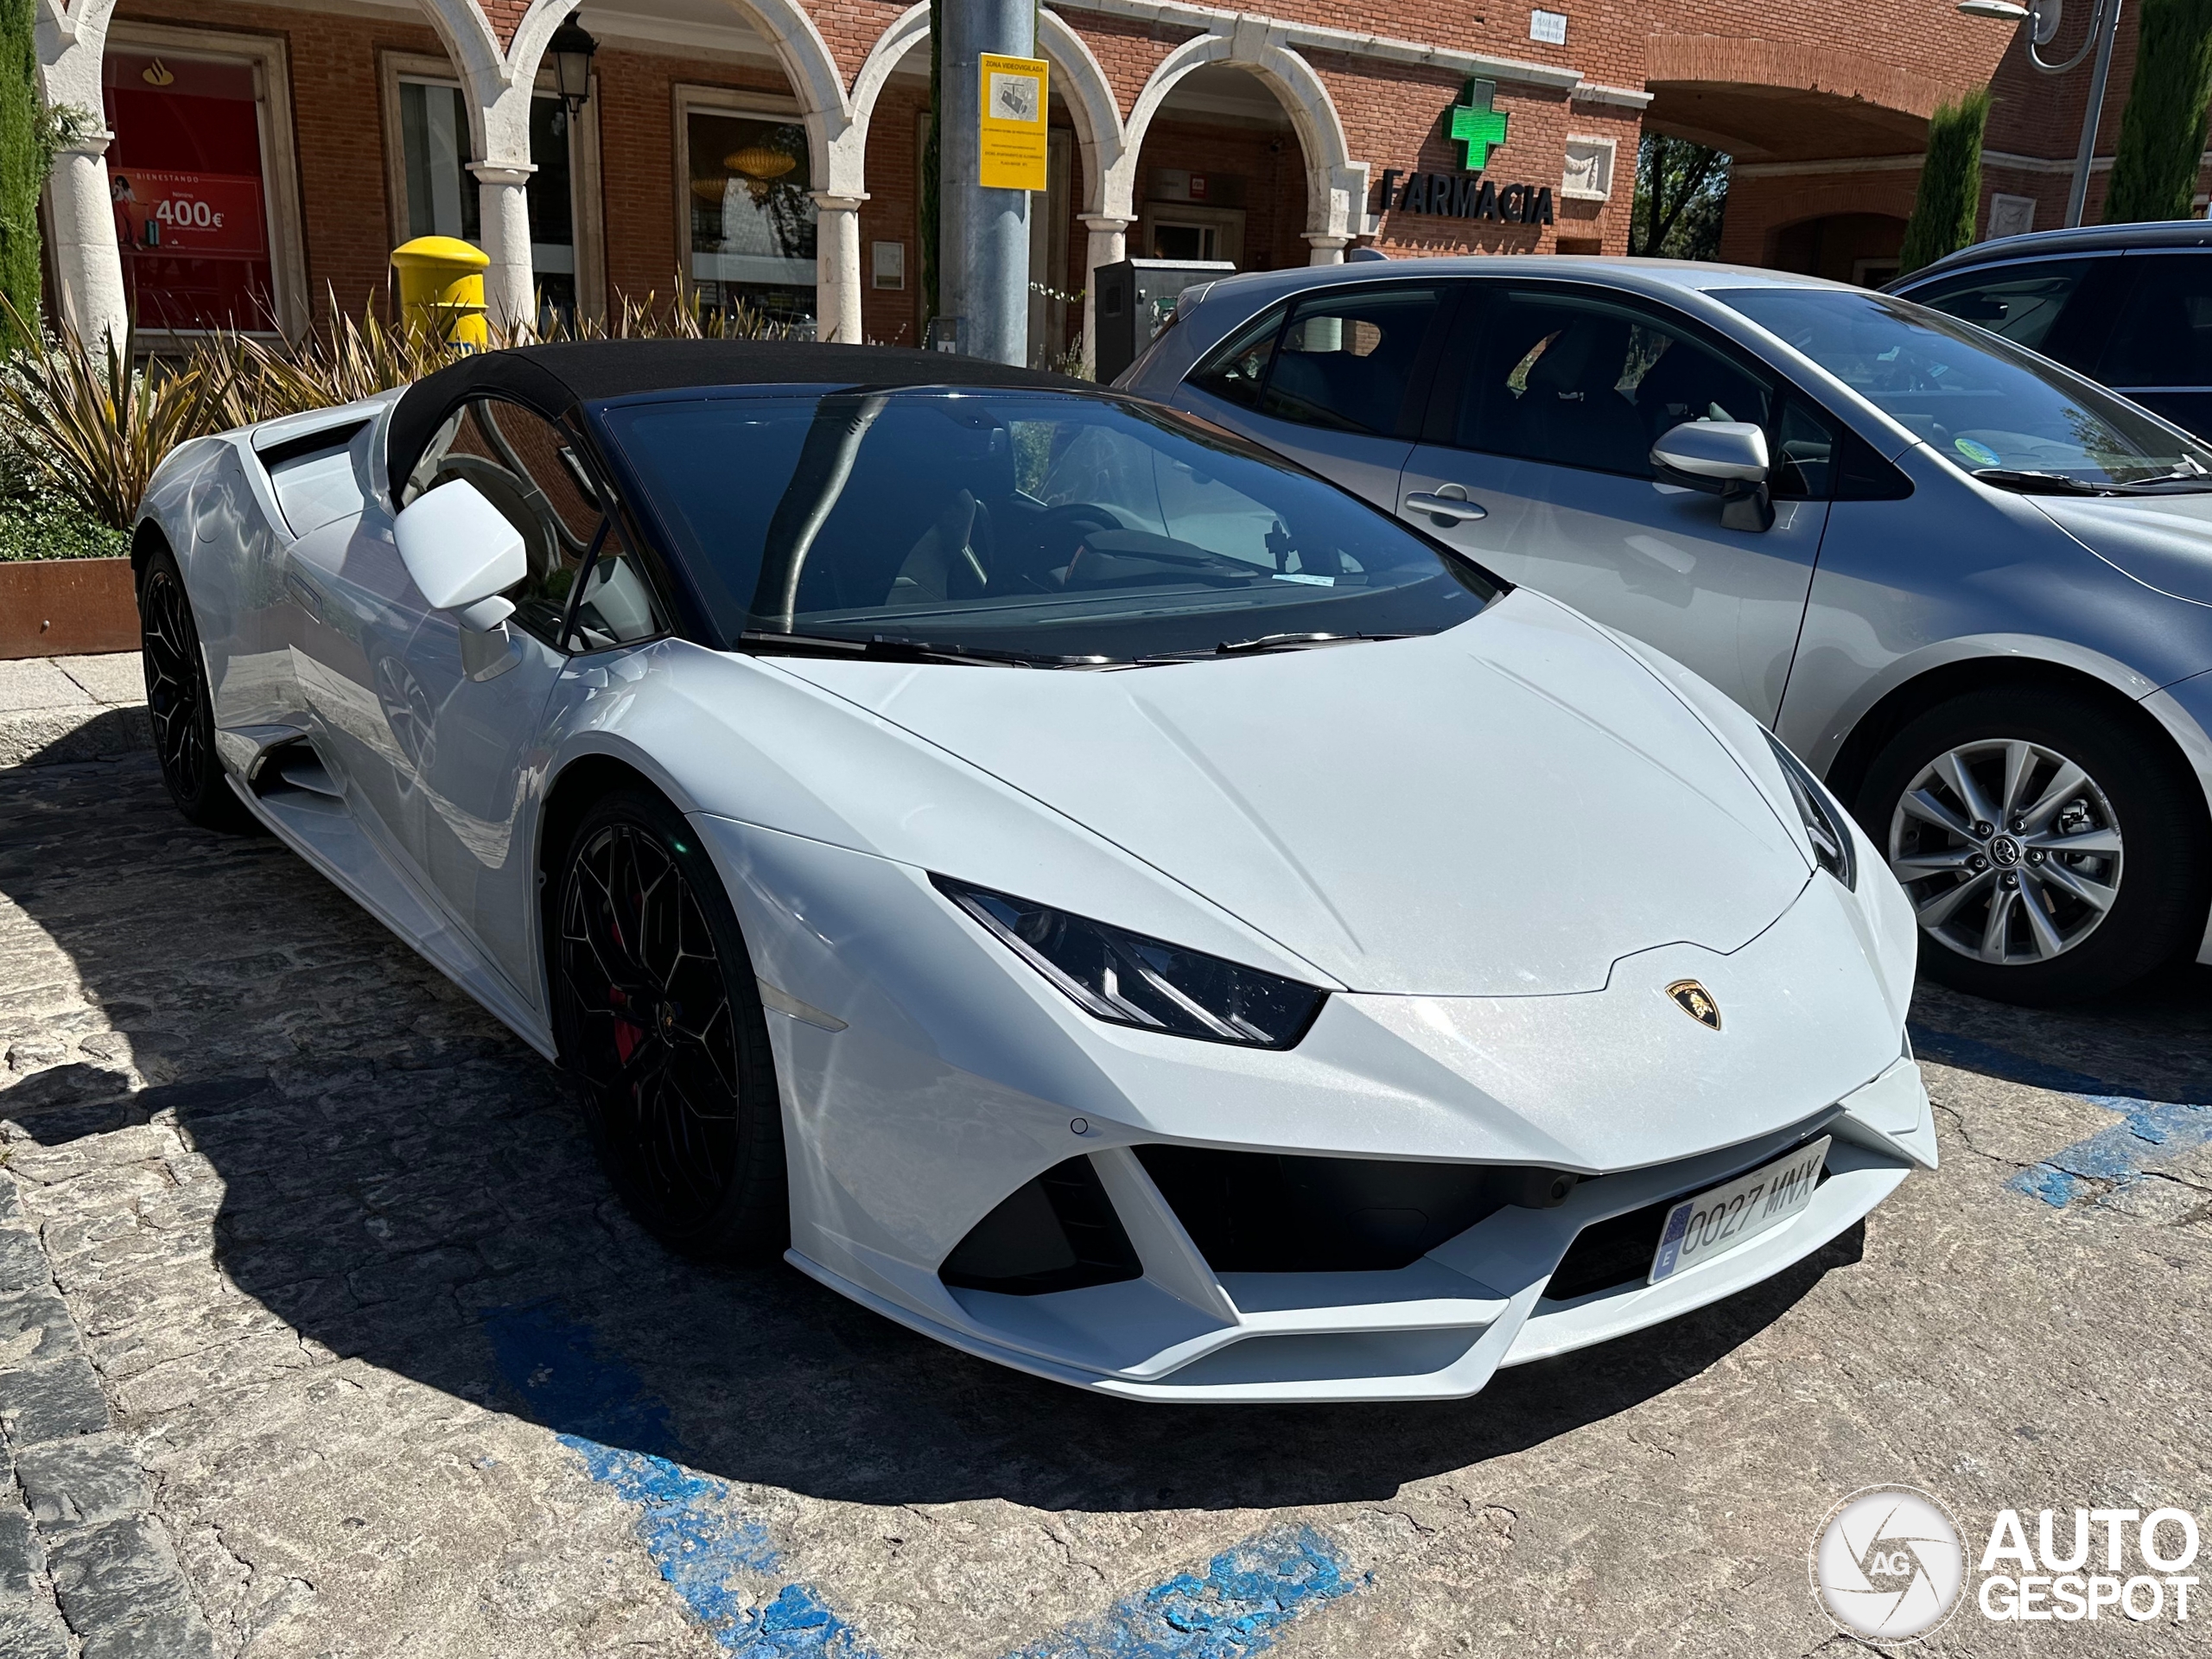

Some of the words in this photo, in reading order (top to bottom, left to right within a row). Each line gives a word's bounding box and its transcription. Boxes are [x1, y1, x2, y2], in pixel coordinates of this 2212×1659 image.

[985, 60, 1001, 68] ZONA
[1002, 62, 1044, 73] VIDEOVIGILADA
[136, 172, 200, 183] BIENESTANDO
[1381, 168, 1554, 226] FARMACIA
[1681, 1183, 1765, 1255] 0027
[1761, 1154, 1821, 1219] MNX
[1662, 1249, 1672, 1268] E
